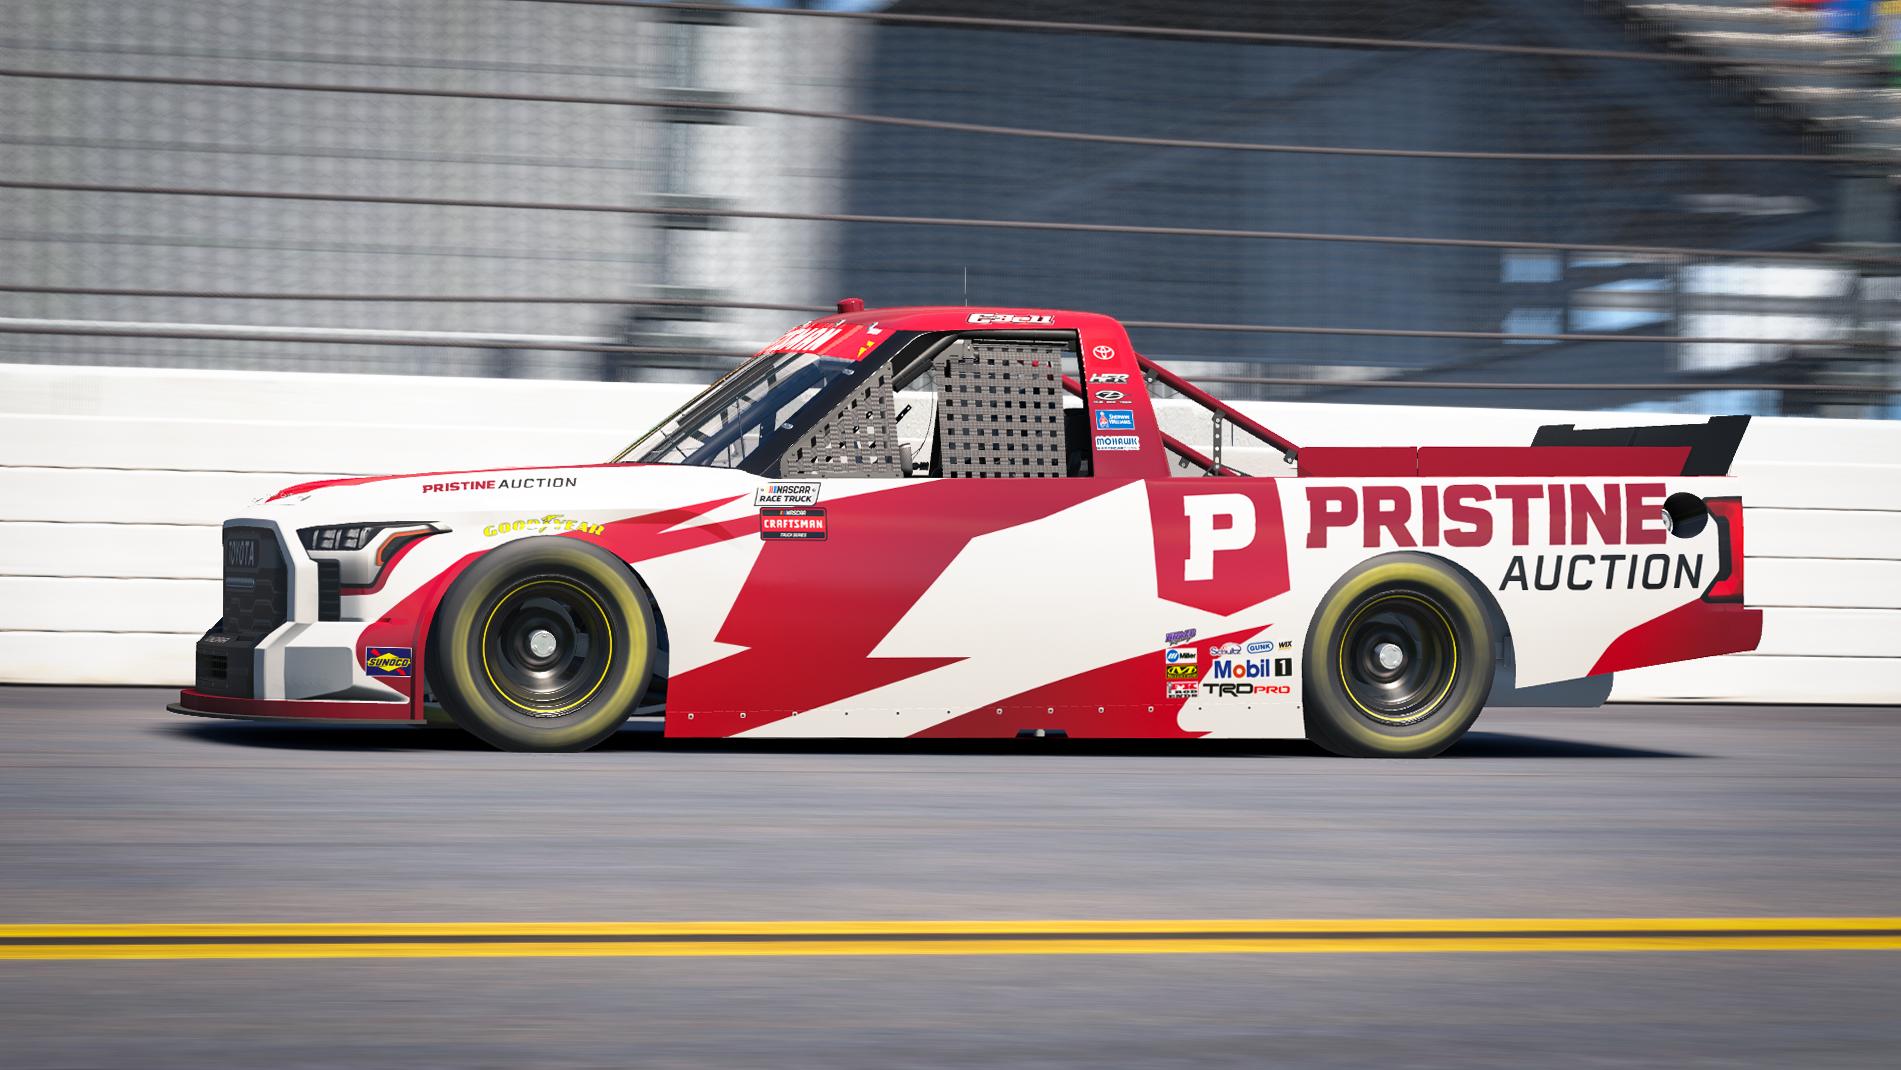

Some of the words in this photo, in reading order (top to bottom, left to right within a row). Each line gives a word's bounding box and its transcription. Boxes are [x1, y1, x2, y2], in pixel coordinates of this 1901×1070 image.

[1096, 437, 1138, 446] MOHAWK
[422, 480, 496, 494] PRISTINE
[498, 477, 578, 490] AUCTION
[776, 485, 811, 494] NASCAR
[784, 495, 812, 503] TRUCK
[1305, 482, 1668, 549] PRISTINE
[483, 515, 605, 538] GOODYEAR
[763, 519, 823, 529] CRAFTSMAN
[1184, 493, 1257, 582] P
[1499, 553, 1704, 591] AUCTION
[1249, 644, 1271, 652] GUNK
[1278, 640, 1293, 649] WIX
[1179, 652, 1196, 660] Miller
[369, 658, 410, 667] SUNOCO
[1214, 658, 1270, 679] Mobil
